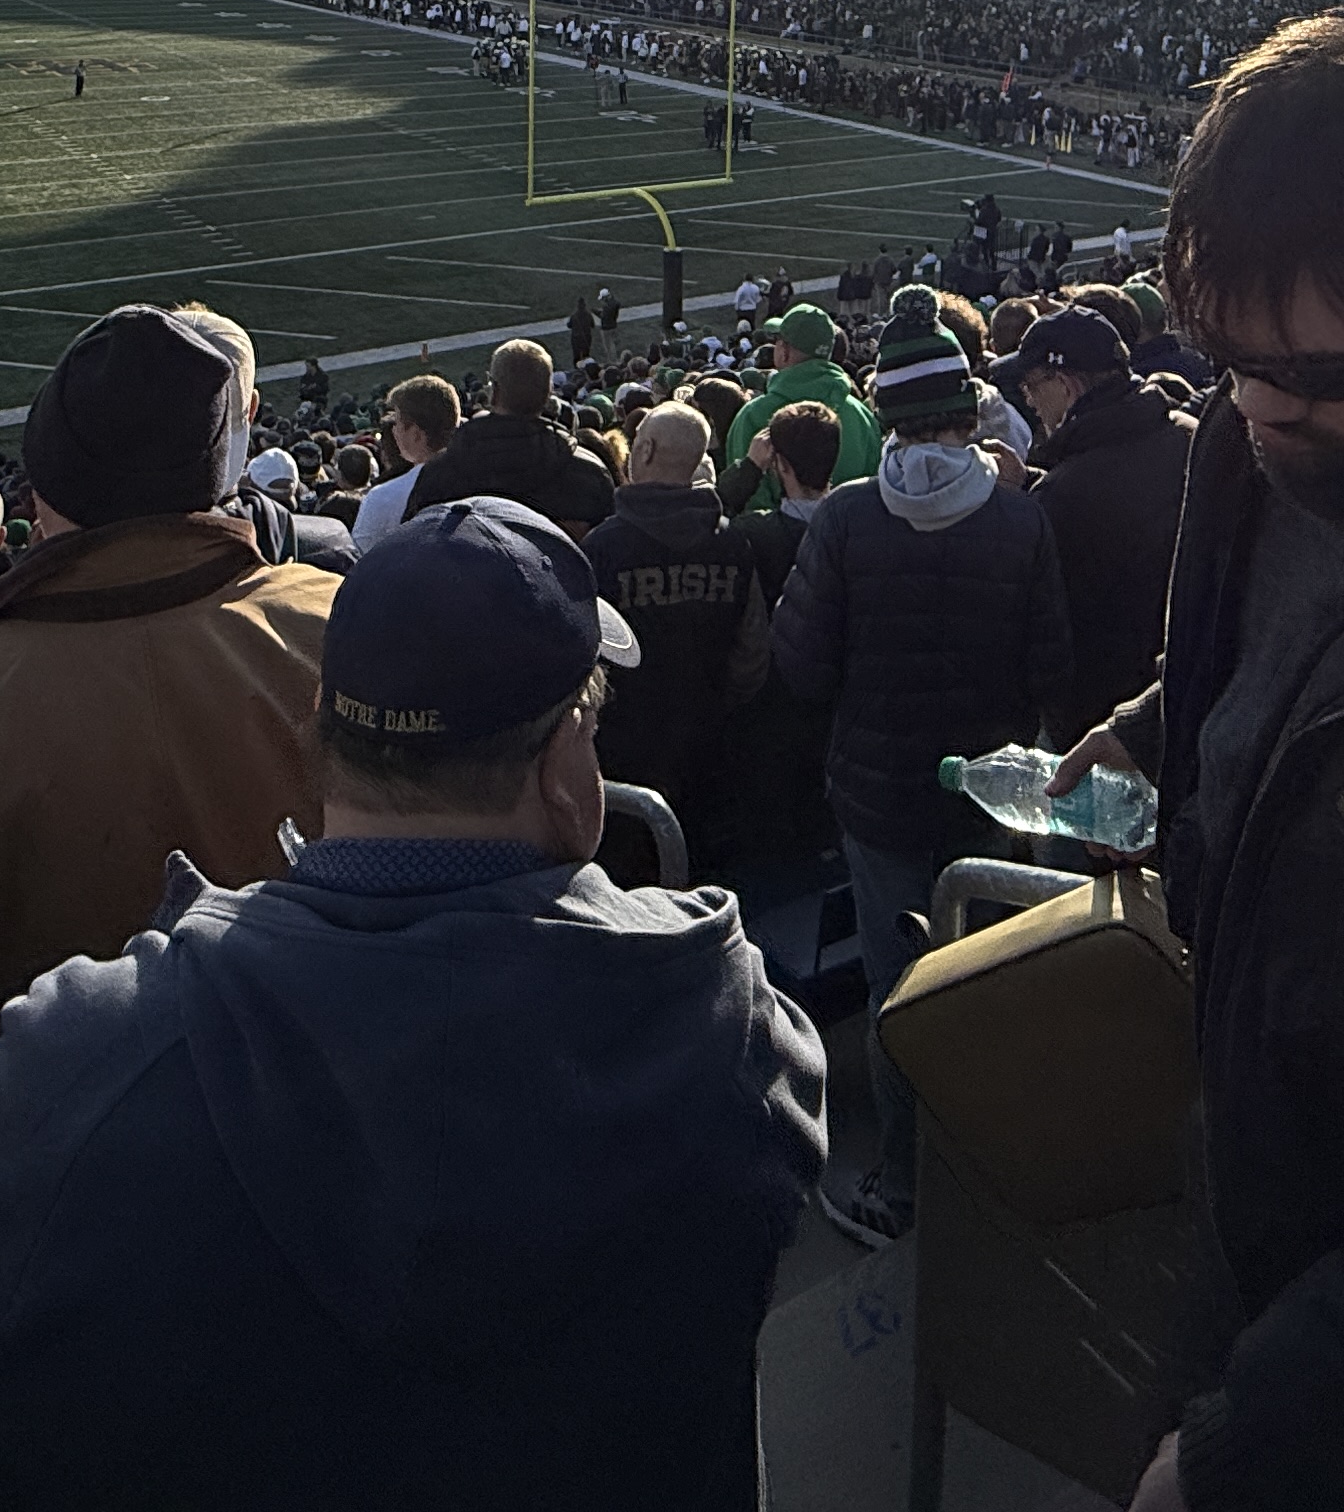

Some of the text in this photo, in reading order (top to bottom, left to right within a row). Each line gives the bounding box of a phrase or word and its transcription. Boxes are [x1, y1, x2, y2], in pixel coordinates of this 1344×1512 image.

[617, 564, 738, 609] IRISH
[333, 689, 440, 733] NOTRE DAME
